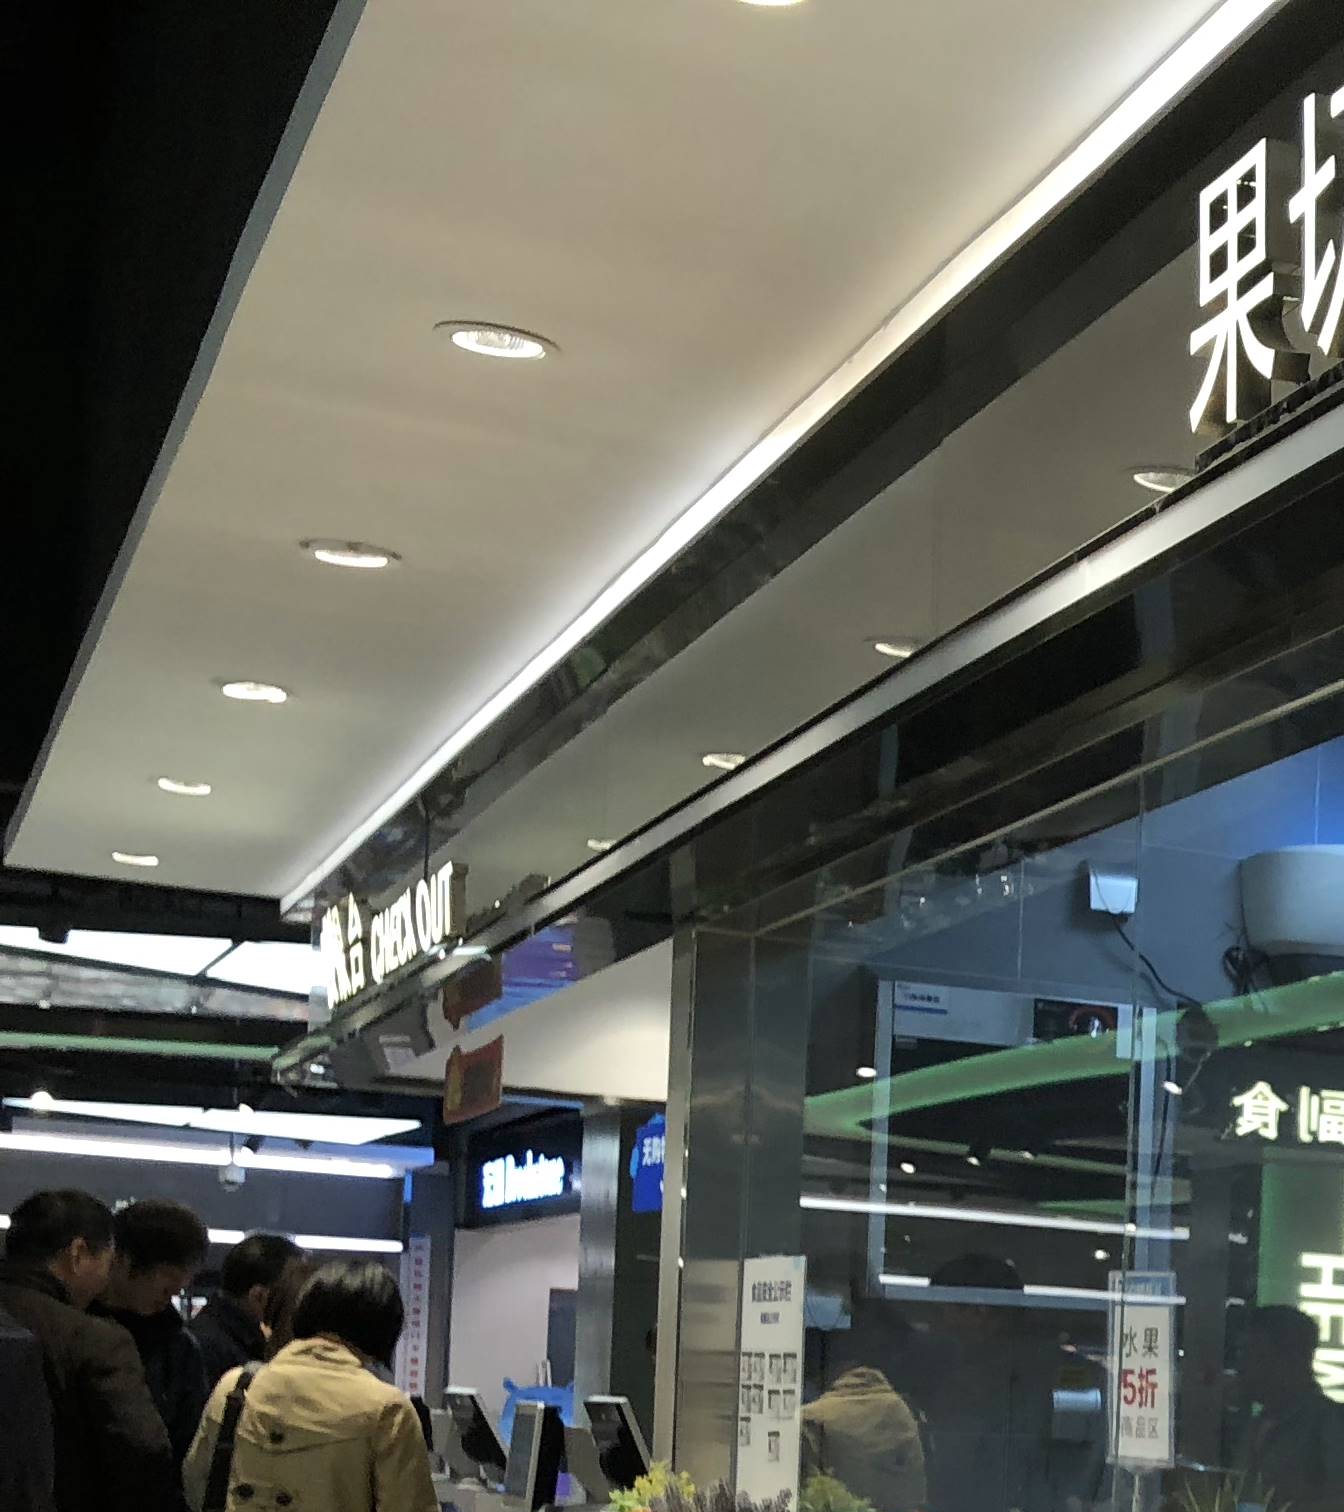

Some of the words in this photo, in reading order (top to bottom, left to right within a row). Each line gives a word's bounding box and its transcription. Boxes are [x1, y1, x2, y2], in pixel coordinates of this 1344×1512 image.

[415, 860, 453, 952] OUT
[1122, 1326, 1159, 1359] 水果
[1121, 1367, 1158, 1409] 5折
